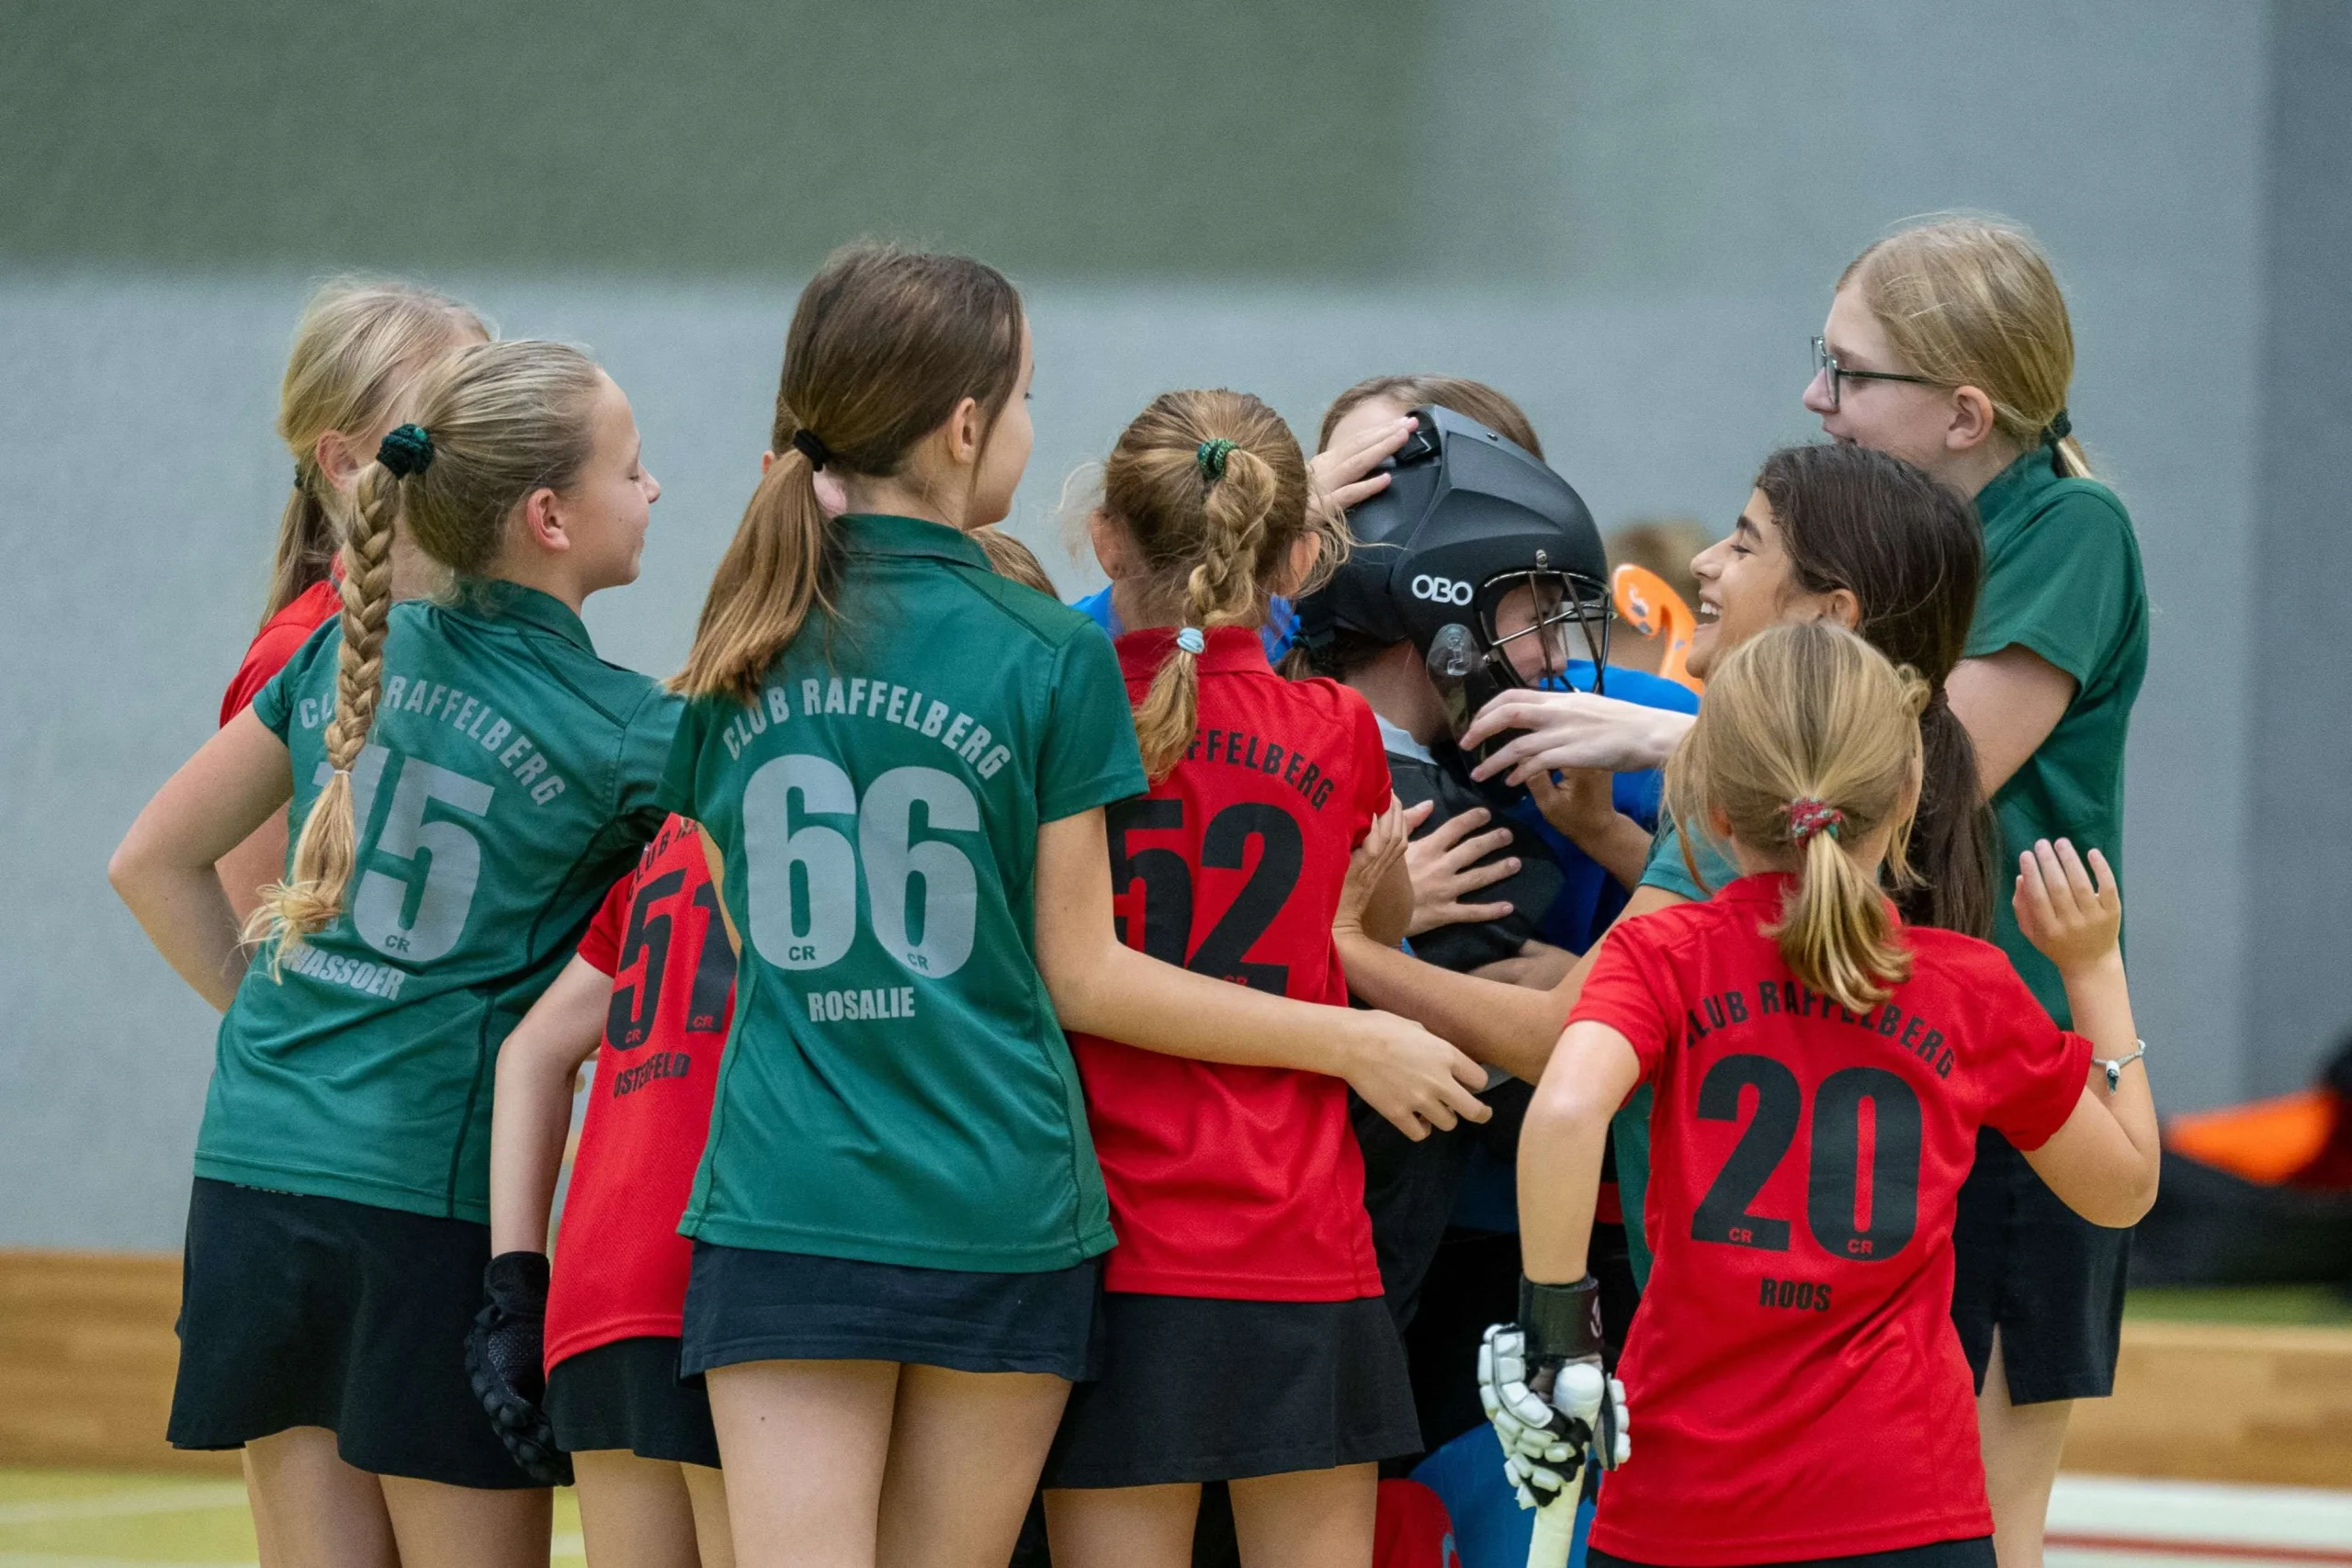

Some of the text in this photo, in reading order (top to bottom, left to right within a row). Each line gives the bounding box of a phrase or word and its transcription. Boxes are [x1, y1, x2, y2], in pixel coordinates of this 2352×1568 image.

[1412, 574, 1473, 606] OBO
[383, 675, 566, 806] RAFFELBERG
[722, 678, 1011, 780] CLUB RAFFELBERG
[1185, 728, 1335, 812] FFELBERG
[742, 753, 980, 979] 66
[1104, 798, 1304, 998] 52
[385, 934, 411, 953] CR
[606, 867, 737, 1051] 51
[788, 945, 816, 962] CR
[907, 953, 930, 971] CR
[693, 1015, 714, 1028] CR
[808, 987, 915, 1022] ROSALIE
[1690, 1054, 1922, 1263] 20
[1729, 1227, 1752, 1244] CR
[1848, 1238, 1874, 1255] CR
[1758, 1278, 1833, 1312] ROOS
